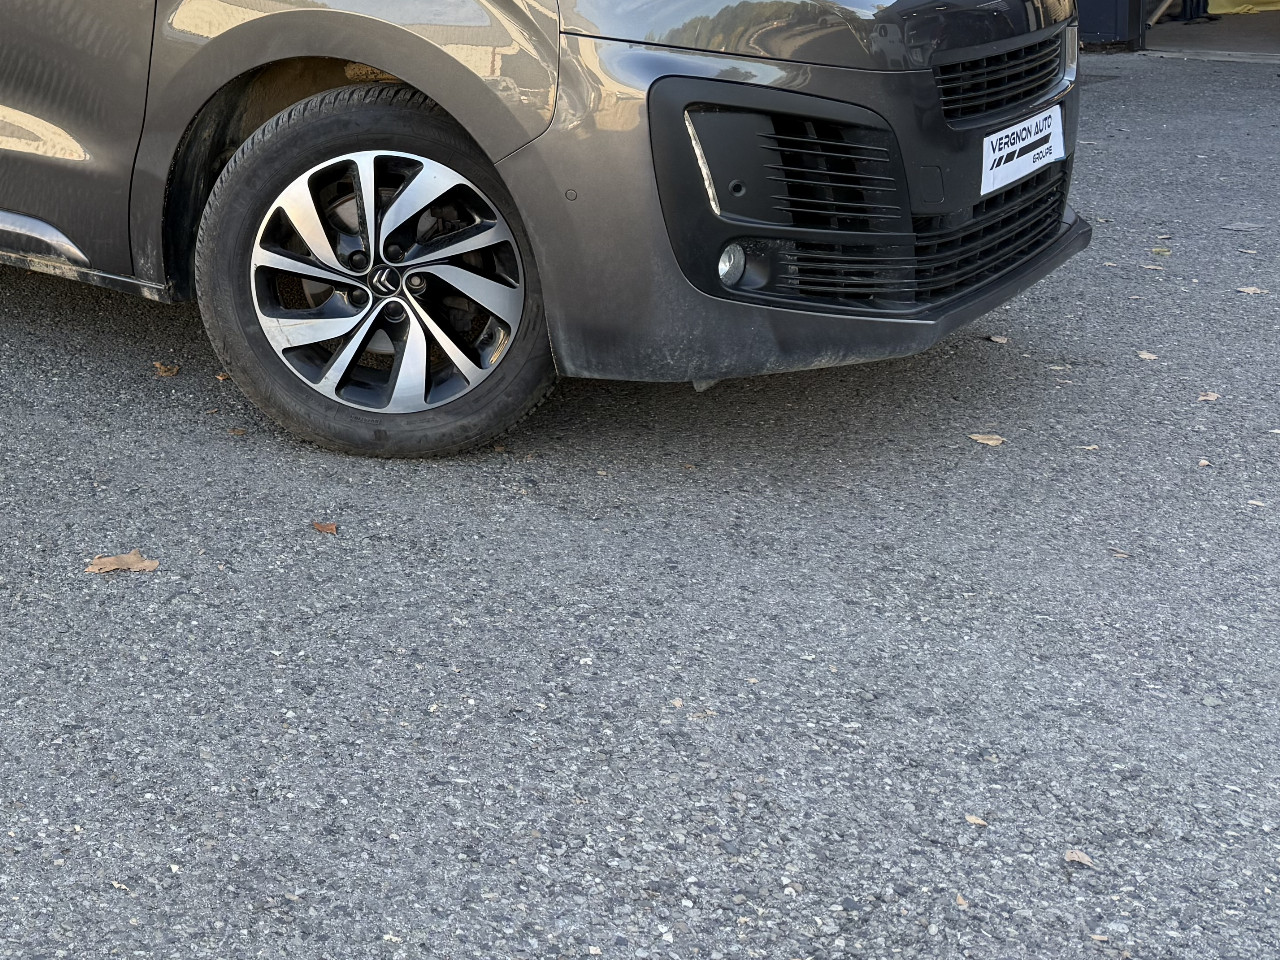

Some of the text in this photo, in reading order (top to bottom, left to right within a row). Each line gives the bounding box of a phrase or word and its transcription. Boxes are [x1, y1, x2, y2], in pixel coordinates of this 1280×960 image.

[990, 114, 1052, 154] VERGNON AUTO
[1032, 145, 1053, 163] GROUPE
